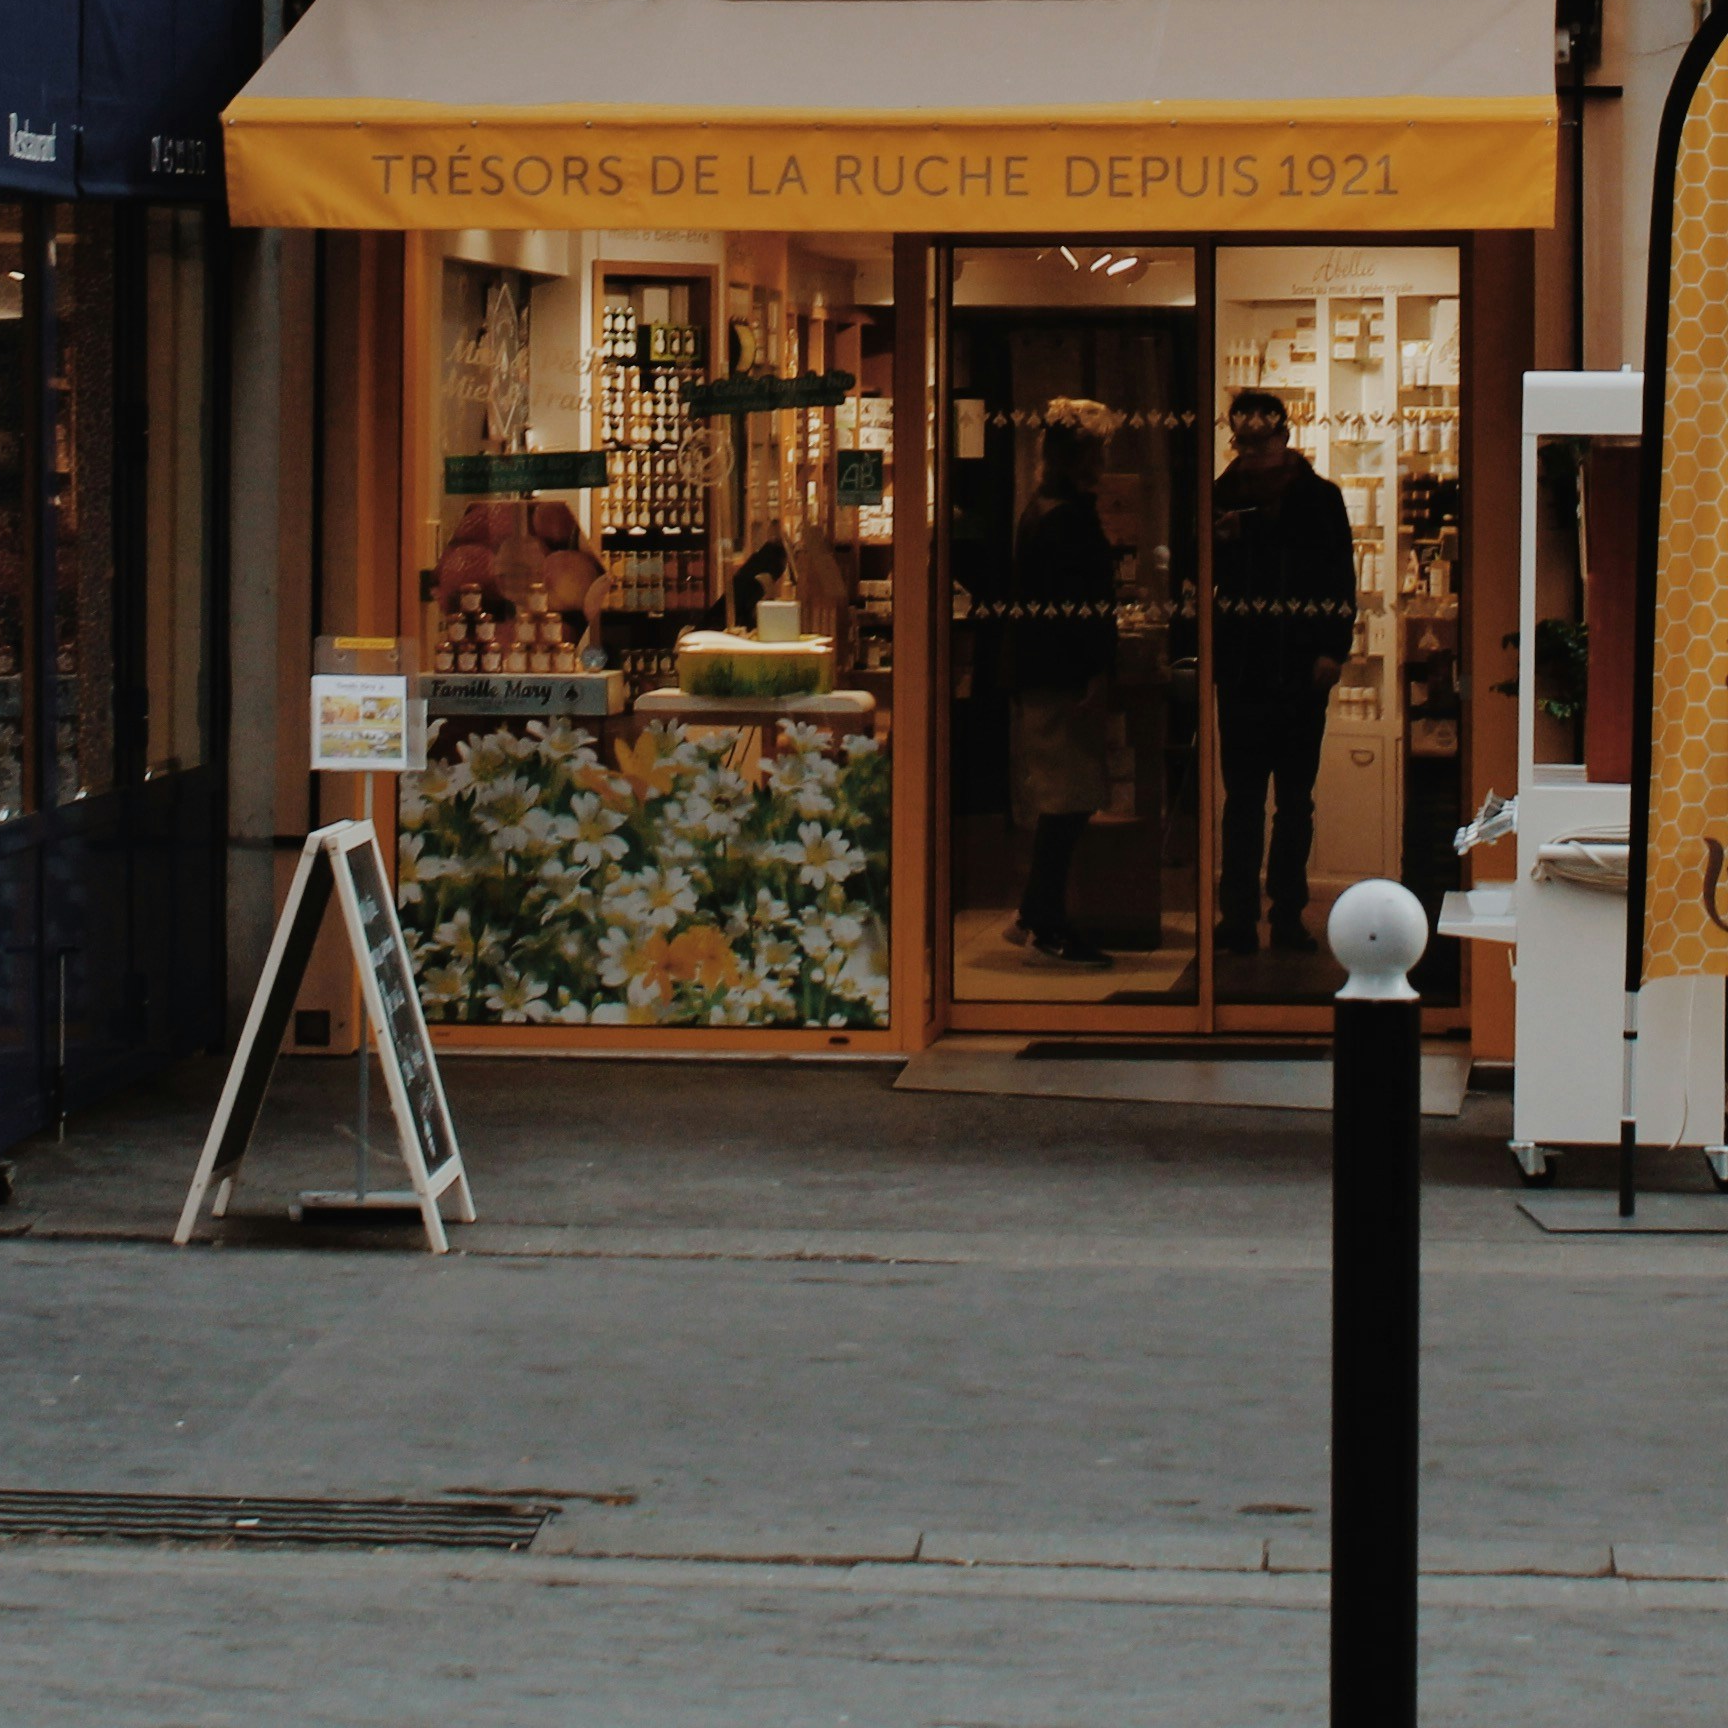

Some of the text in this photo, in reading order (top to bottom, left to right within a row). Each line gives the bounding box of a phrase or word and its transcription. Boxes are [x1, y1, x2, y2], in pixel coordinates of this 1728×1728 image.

[372, 145, 1399, 197] TRÉSORS DE LA RUCHE DEPUIS 1921
[432, 679, 552, 706] Famille Mary
